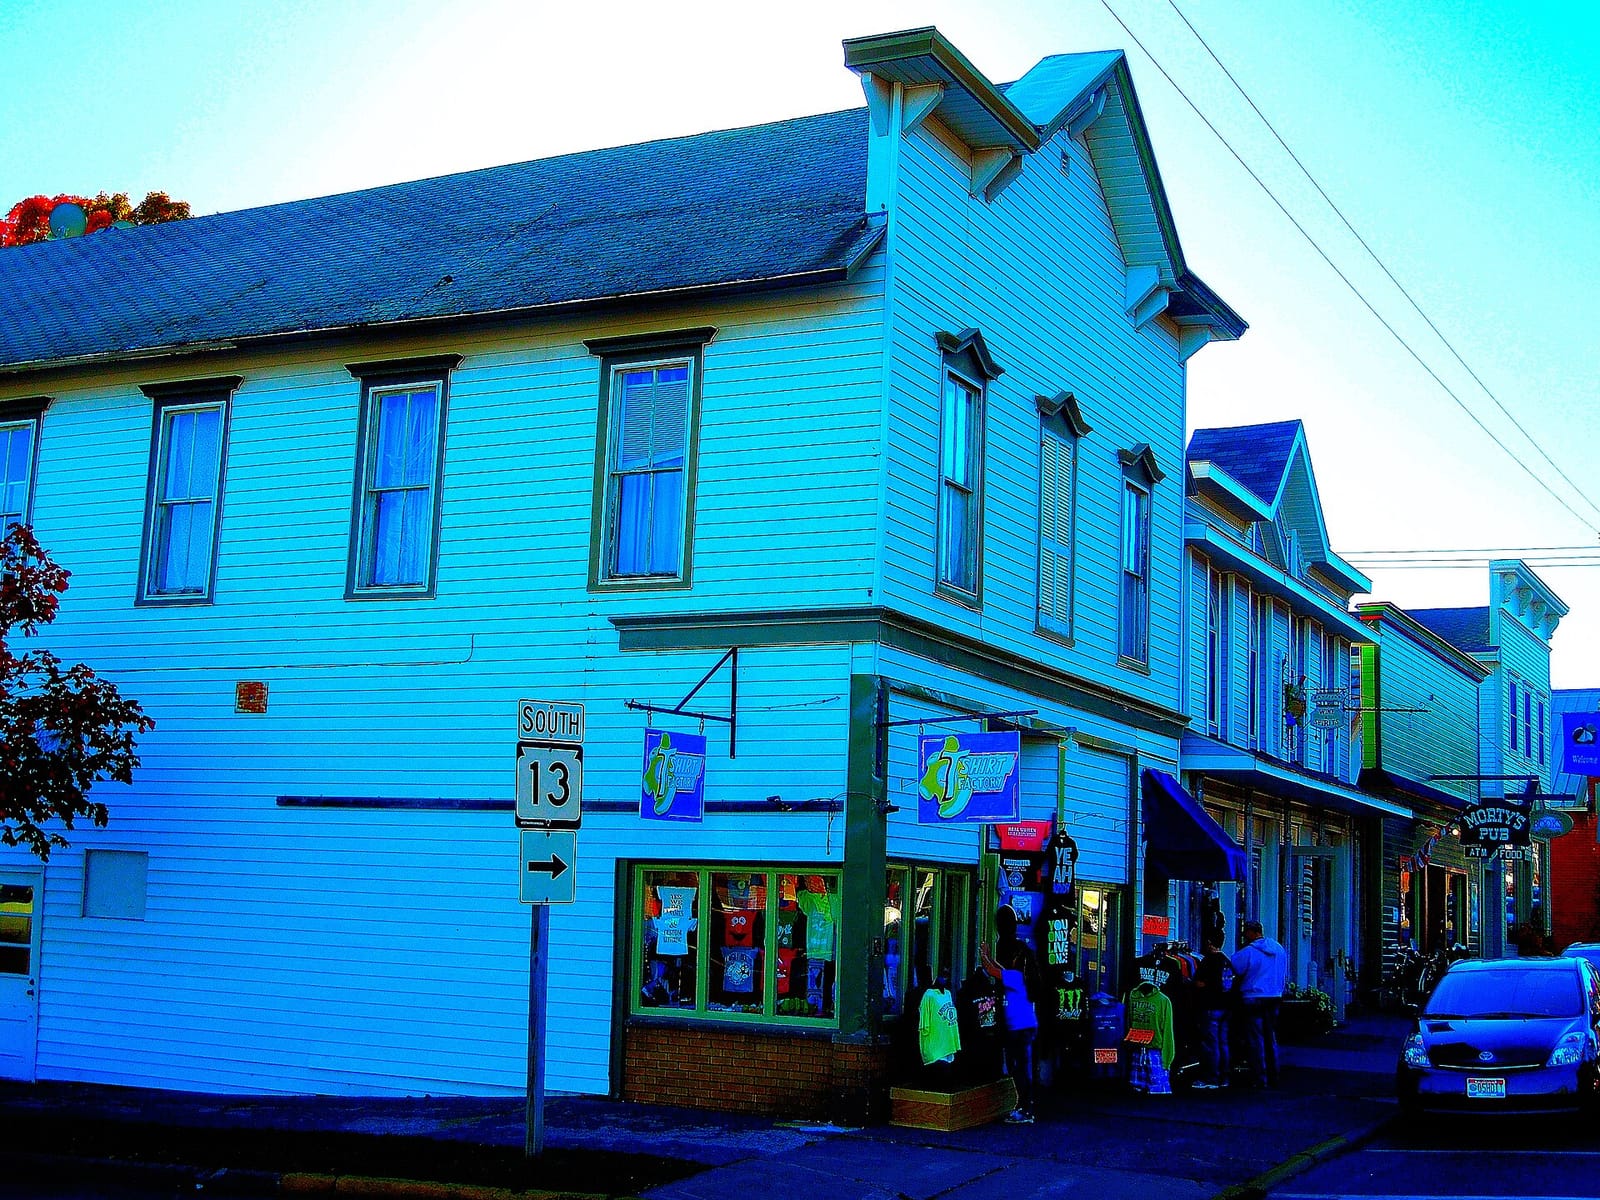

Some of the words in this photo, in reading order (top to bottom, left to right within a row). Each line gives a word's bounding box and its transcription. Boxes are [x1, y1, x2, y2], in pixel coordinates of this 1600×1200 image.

[522, 705, 581, 736] SOUTH
[1313, 718, 1340, 727] SPIRITS
[529, 760, 571, 808] 13
[957, 776, 1003, 791] FACTORY
[1463, 807, 1527, 830] MORTY'S
[1479, 827, 1509, 841] PUB
[1469, 847, 1488, 857] ATM
[1499, 849, 1523, 859] FOOD
[1047, 918, 1069, 931] YOU
[1047, 930, 1069, 943] ONLY
[1047, 941, 1069, 954] LIVE
